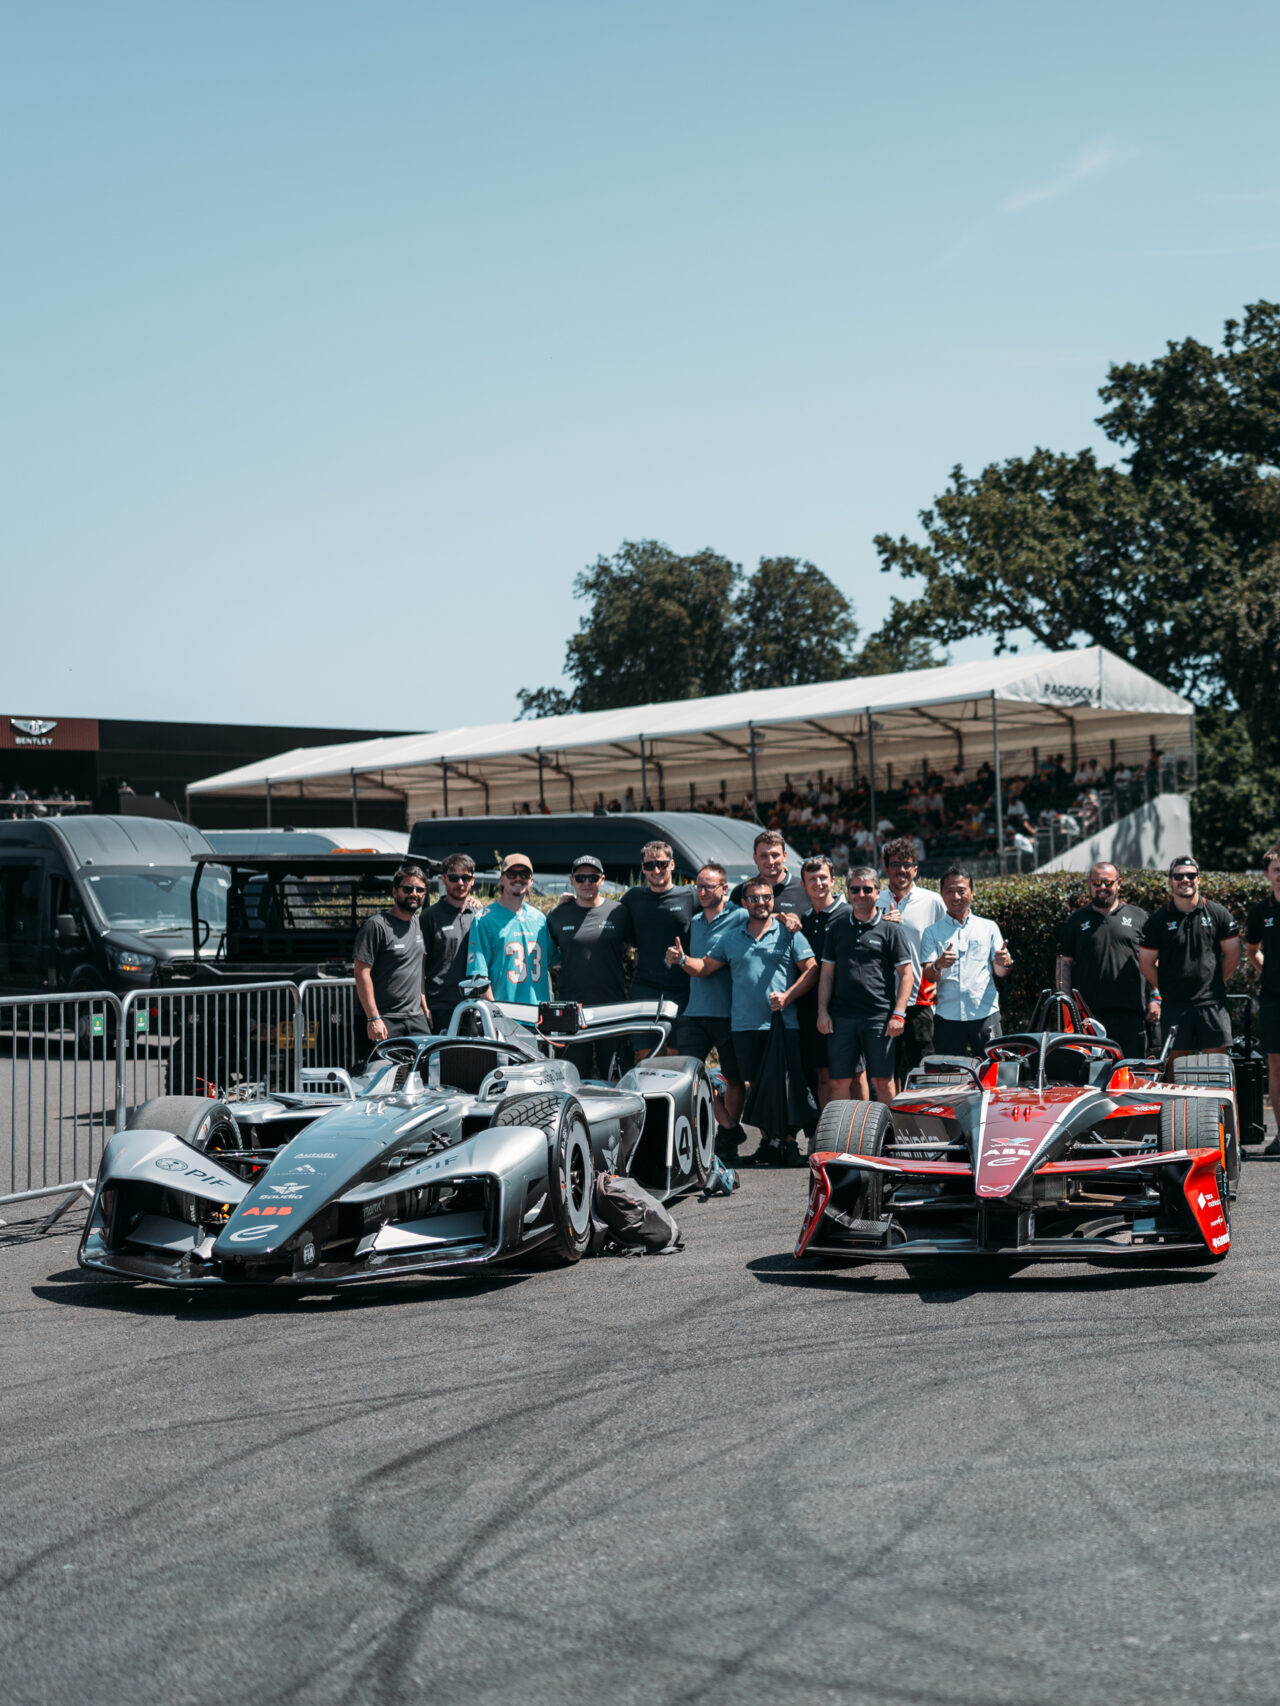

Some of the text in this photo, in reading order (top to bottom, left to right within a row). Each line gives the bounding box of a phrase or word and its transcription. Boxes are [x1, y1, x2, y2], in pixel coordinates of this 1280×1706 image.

[1044, 684, 1093, 698] PADDOCK
[15, 736, 53, 746] BENTLEY
[505, 941, 542, 984] 33
[679, 1126, 690, 1160] 4
[982, 1149, 1031, 1157] ABB
[184, 1169, 232, 1187] PIF
[241, 1206, 293, 1216] ABB
